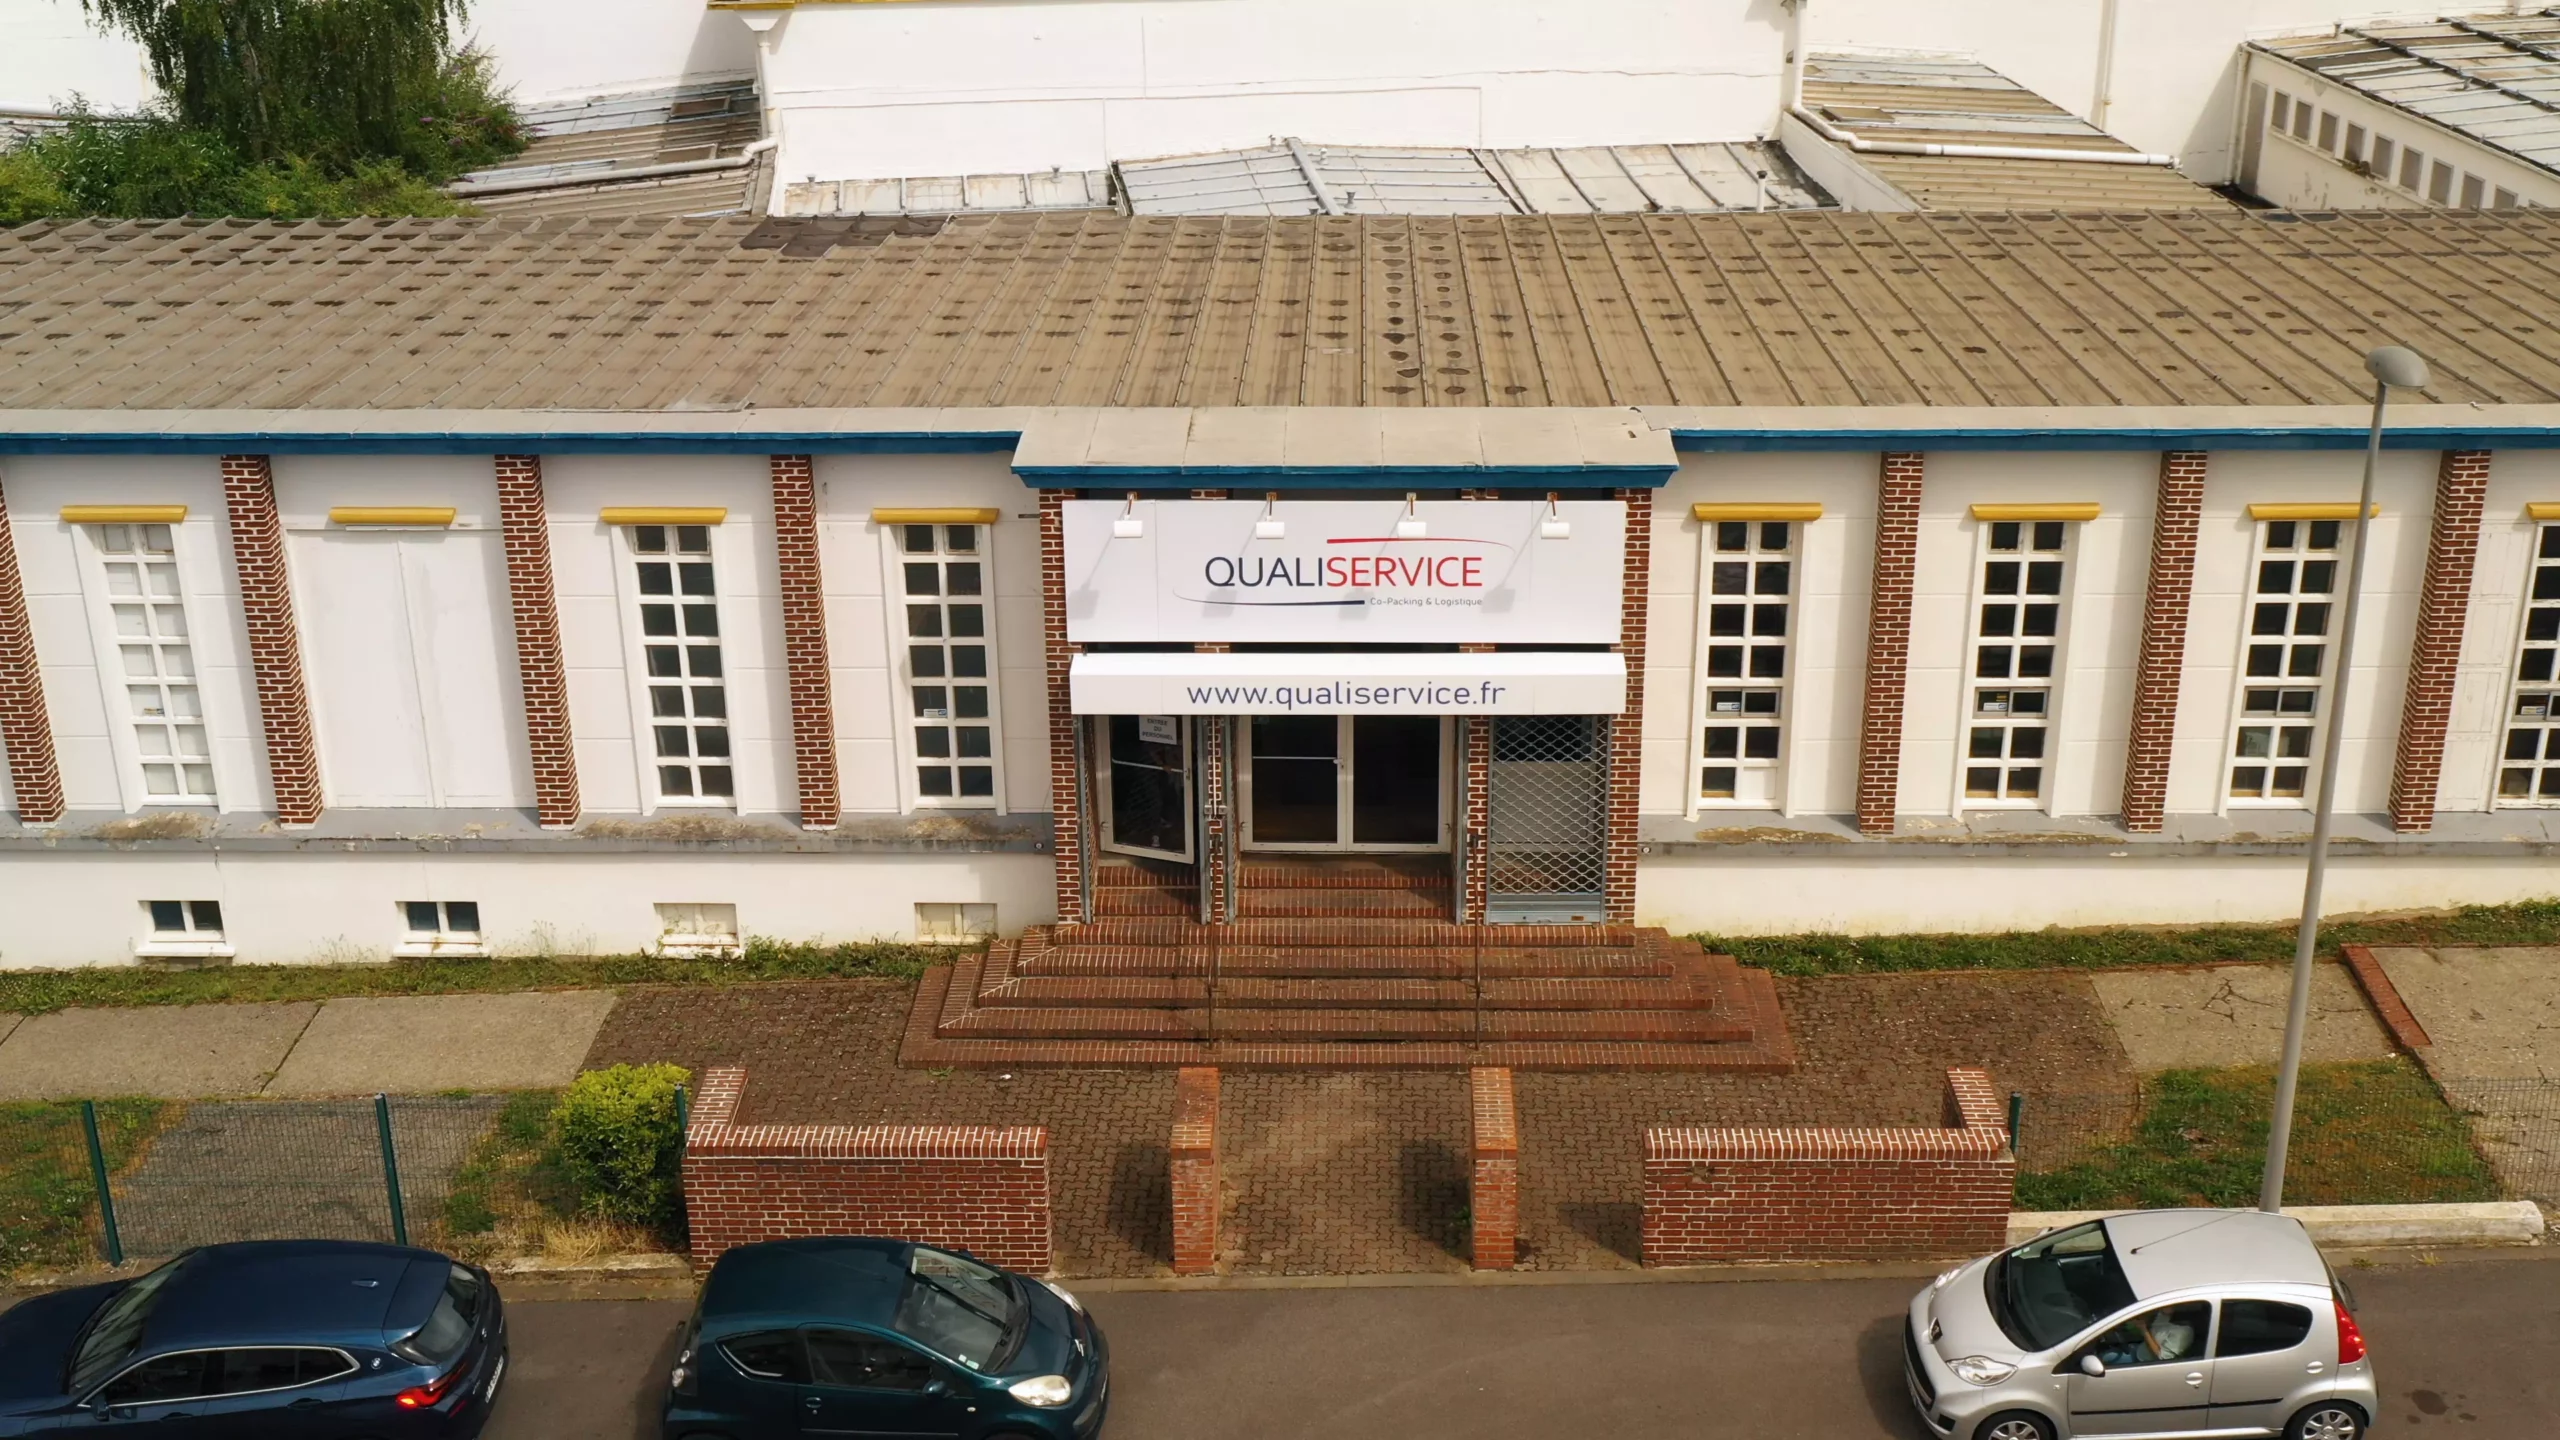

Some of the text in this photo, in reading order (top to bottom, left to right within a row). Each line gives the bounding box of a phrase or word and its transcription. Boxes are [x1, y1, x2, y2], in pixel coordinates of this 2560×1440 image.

[1204, 556, 1483, 588] QUALISERVICE
[1369, 596, 1483, 608] Co-Packing & Logistique
[1186, 680, 1506, 711] www.qualiservice.fr
